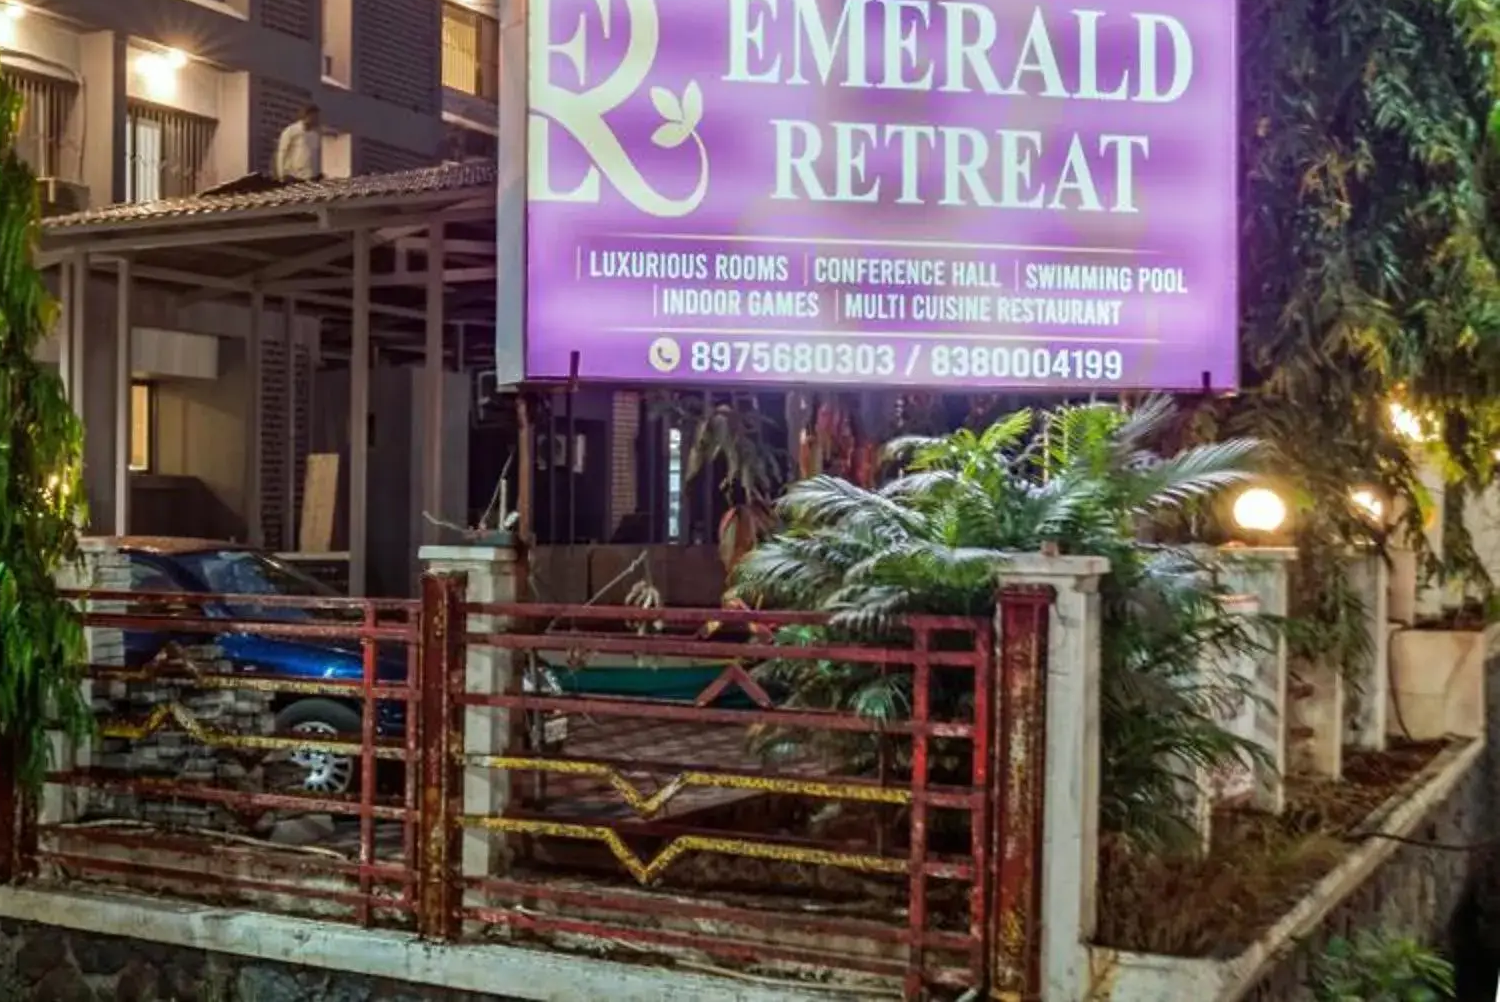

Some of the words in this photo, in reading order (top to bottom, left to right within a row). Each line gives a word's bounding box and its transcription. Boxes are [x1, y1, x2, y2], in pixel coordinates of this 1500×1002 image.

[770, 119, 1151, 213] RETREAT
[589, 251, 708, 280] LUXURIOUS
[715, 254, 788, 282] ROOMS
[814, 257, 946, 286] CONFERENCE
[951, 260, 1002, 288] HALL
[1025, 263, 1132, 292] SWIMMING
[1138, 267, 1188, 293] POOL
[663, 288, 741, 315] INDOOR
[748, 291, 820, 317] GAMES
[845, 293, 906, 320] MULTI
[912, 295, 992, 322] CUISINE
[997, 297, 1123, 326] RESTAURANT
[691, 341, 895, 376] 8975680303
[930, 345, 1124, 380] 8380004199
